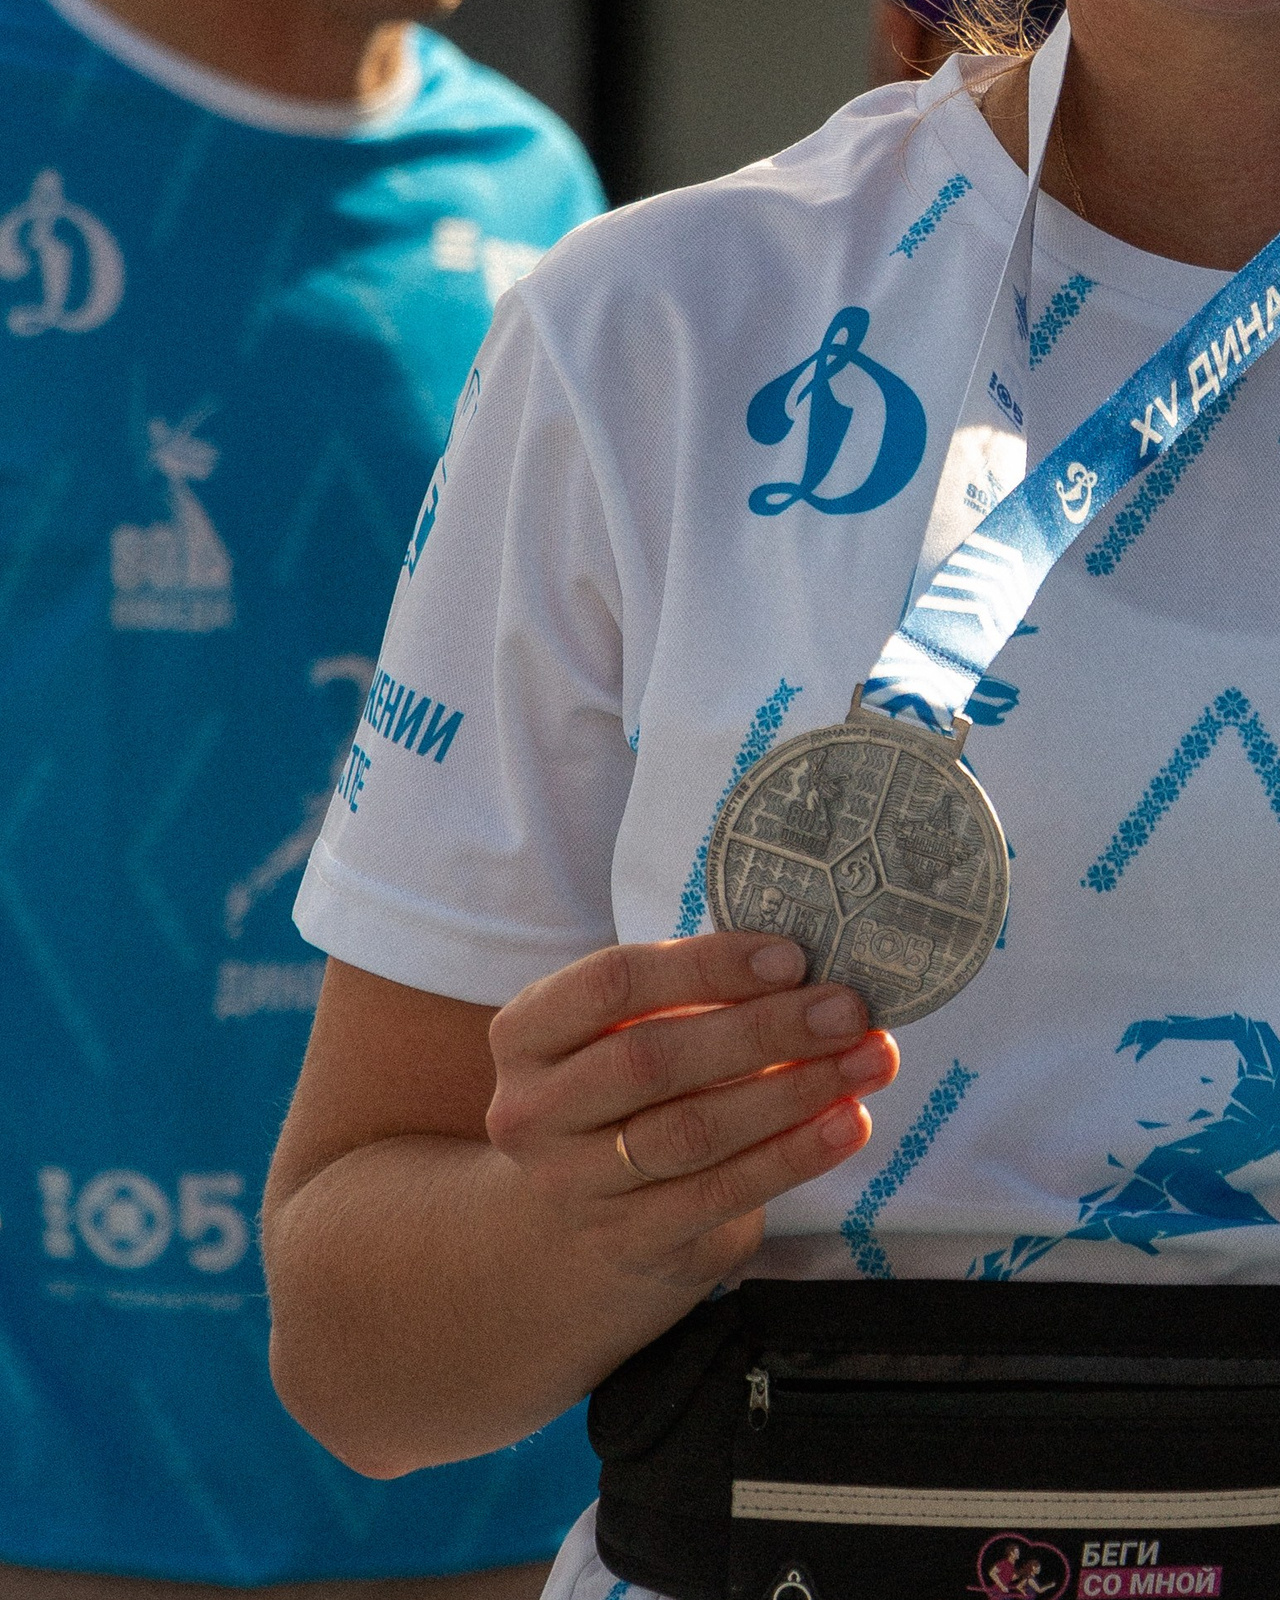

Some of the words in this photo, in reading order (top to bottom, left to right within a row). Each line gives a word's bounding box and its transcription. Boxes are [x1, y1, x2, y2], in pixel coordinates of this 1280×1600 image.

[1082, 1540, 1160, 1568] БЕГИ
[1083, 1573, 1122, 1598] СО
[1129, 1565, 1216, 1596] МНОЙ
